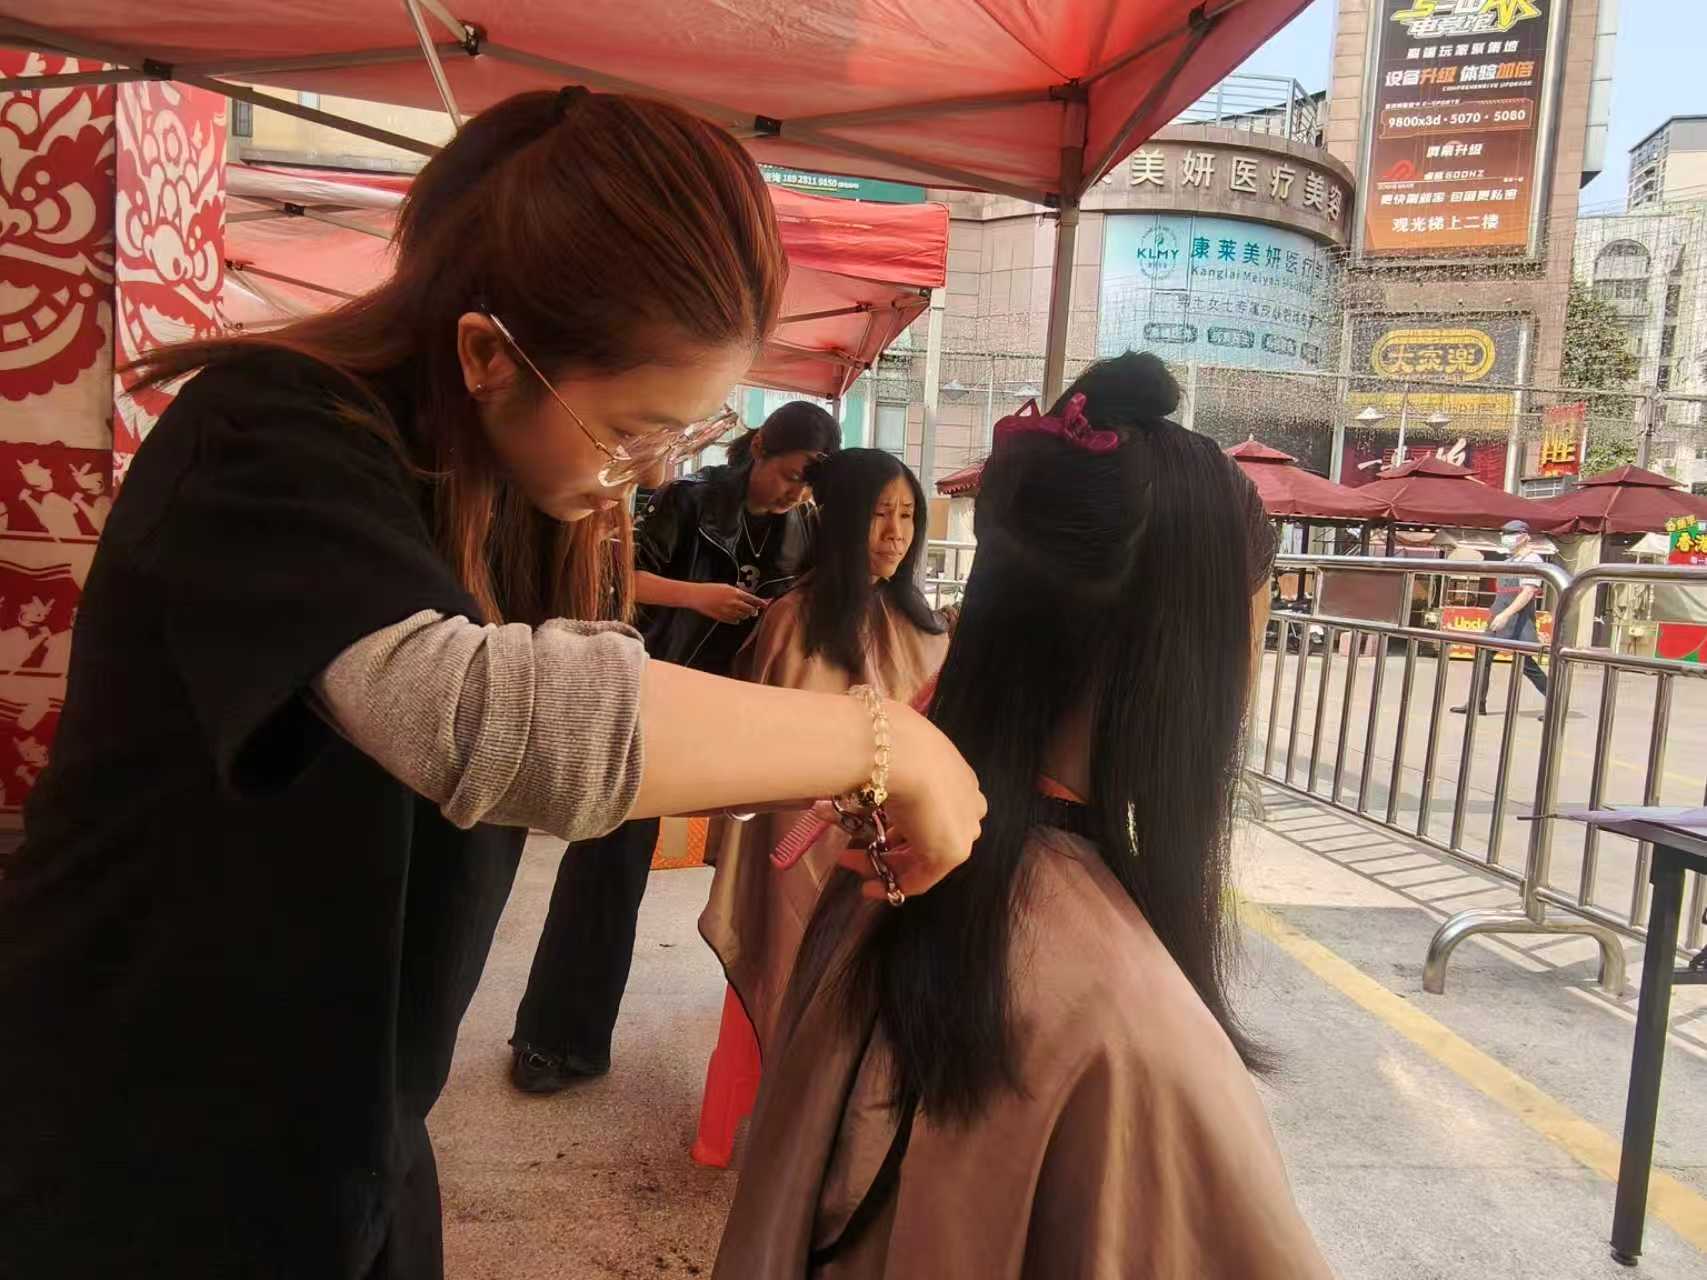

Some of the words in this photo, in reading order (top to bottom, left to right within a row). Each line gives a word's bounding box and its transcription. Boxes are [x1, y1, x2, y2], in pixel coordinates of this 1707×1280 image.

[1385, 66, 1457, 87] 设备升级
[1459, 61, 1535, 82] 体验加倍
[1388, 114, 1441, 129] 9800x3d
[1450, 112, 1481, 125] 5070
[1494, 109, 1526, 122] 5080
[1100, 150, 1342, 221] 美妍医疗美容
[1392, 214, 1499, 233] 观光梯上二楼
[1137, 248, 1179, 259] KLMY
